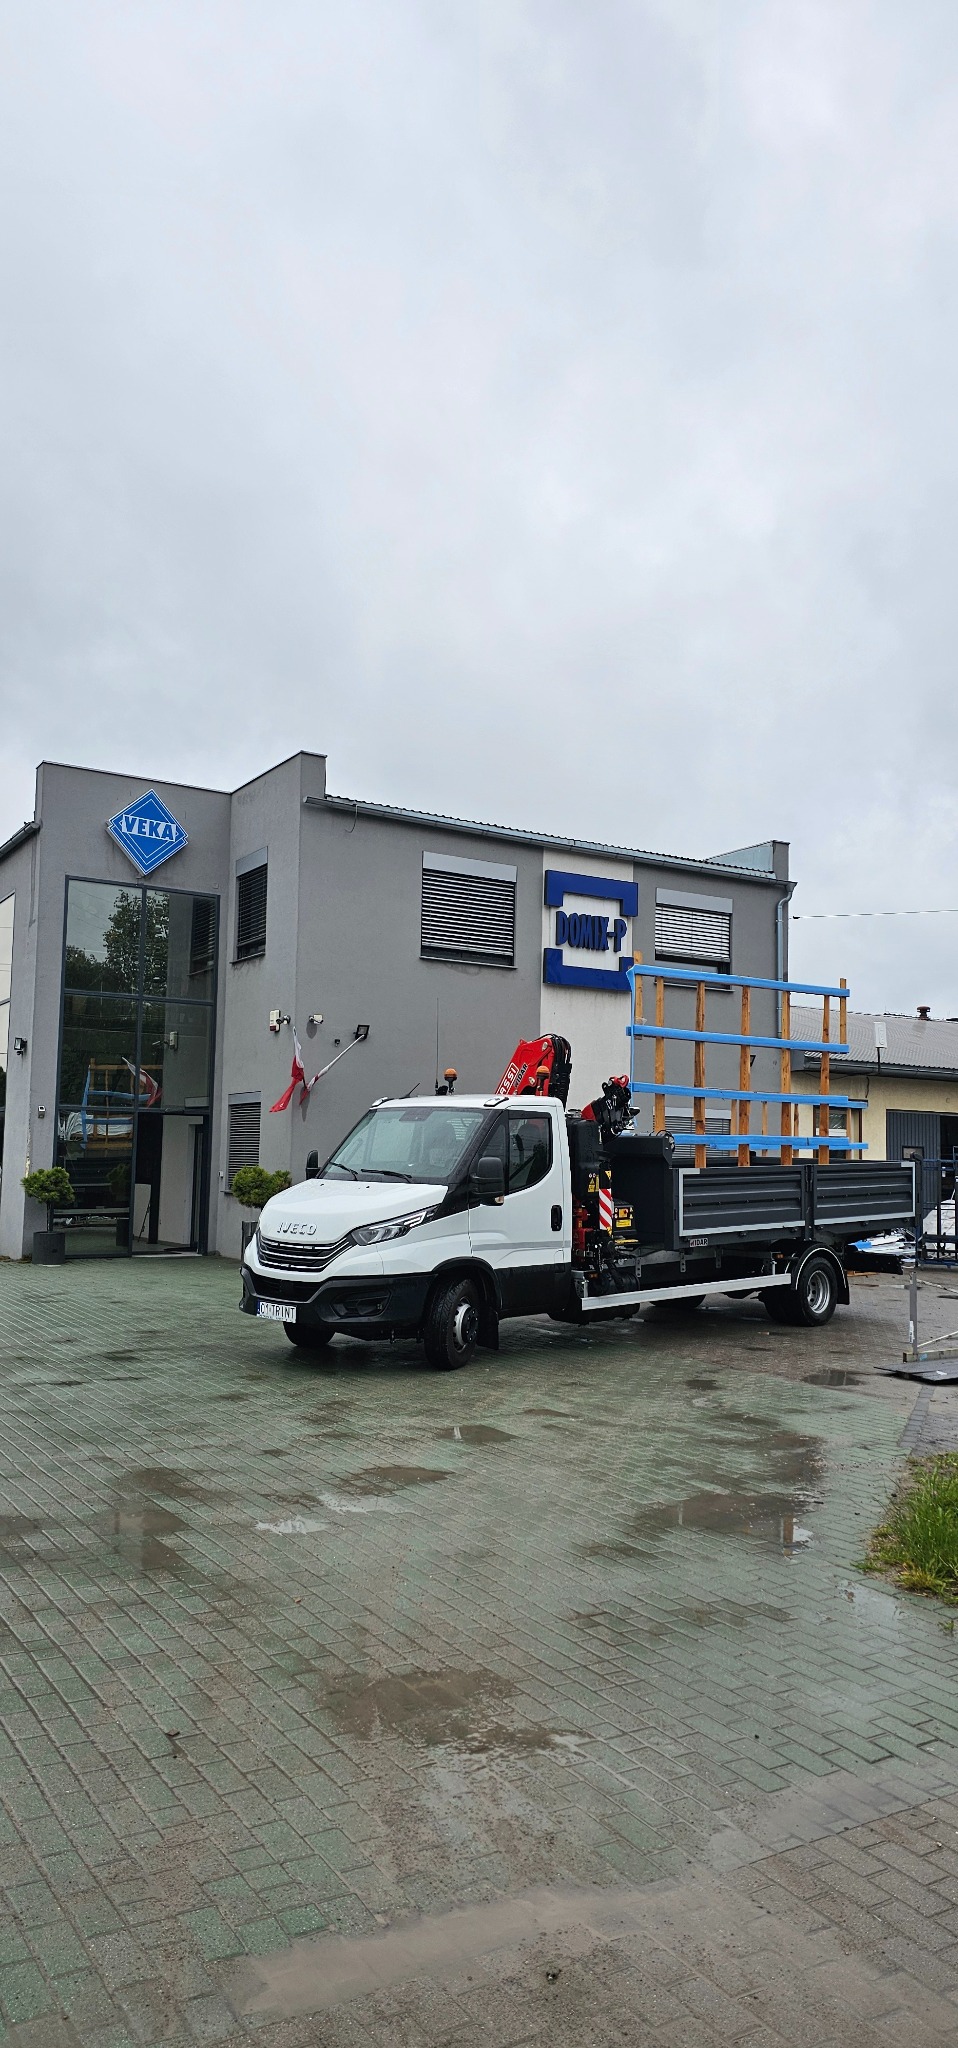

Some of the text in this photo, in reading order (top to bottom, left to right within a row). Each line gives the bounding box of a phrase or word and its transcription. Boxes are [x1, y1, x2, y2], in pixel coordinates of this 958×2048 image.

[124, 815, 174, 840] VEKA
[556, 911, 627, 952] DOMIX-P
[500, 1067, 516, 1095] ASSI
[277, 1222, 317, 1235] IVECO
